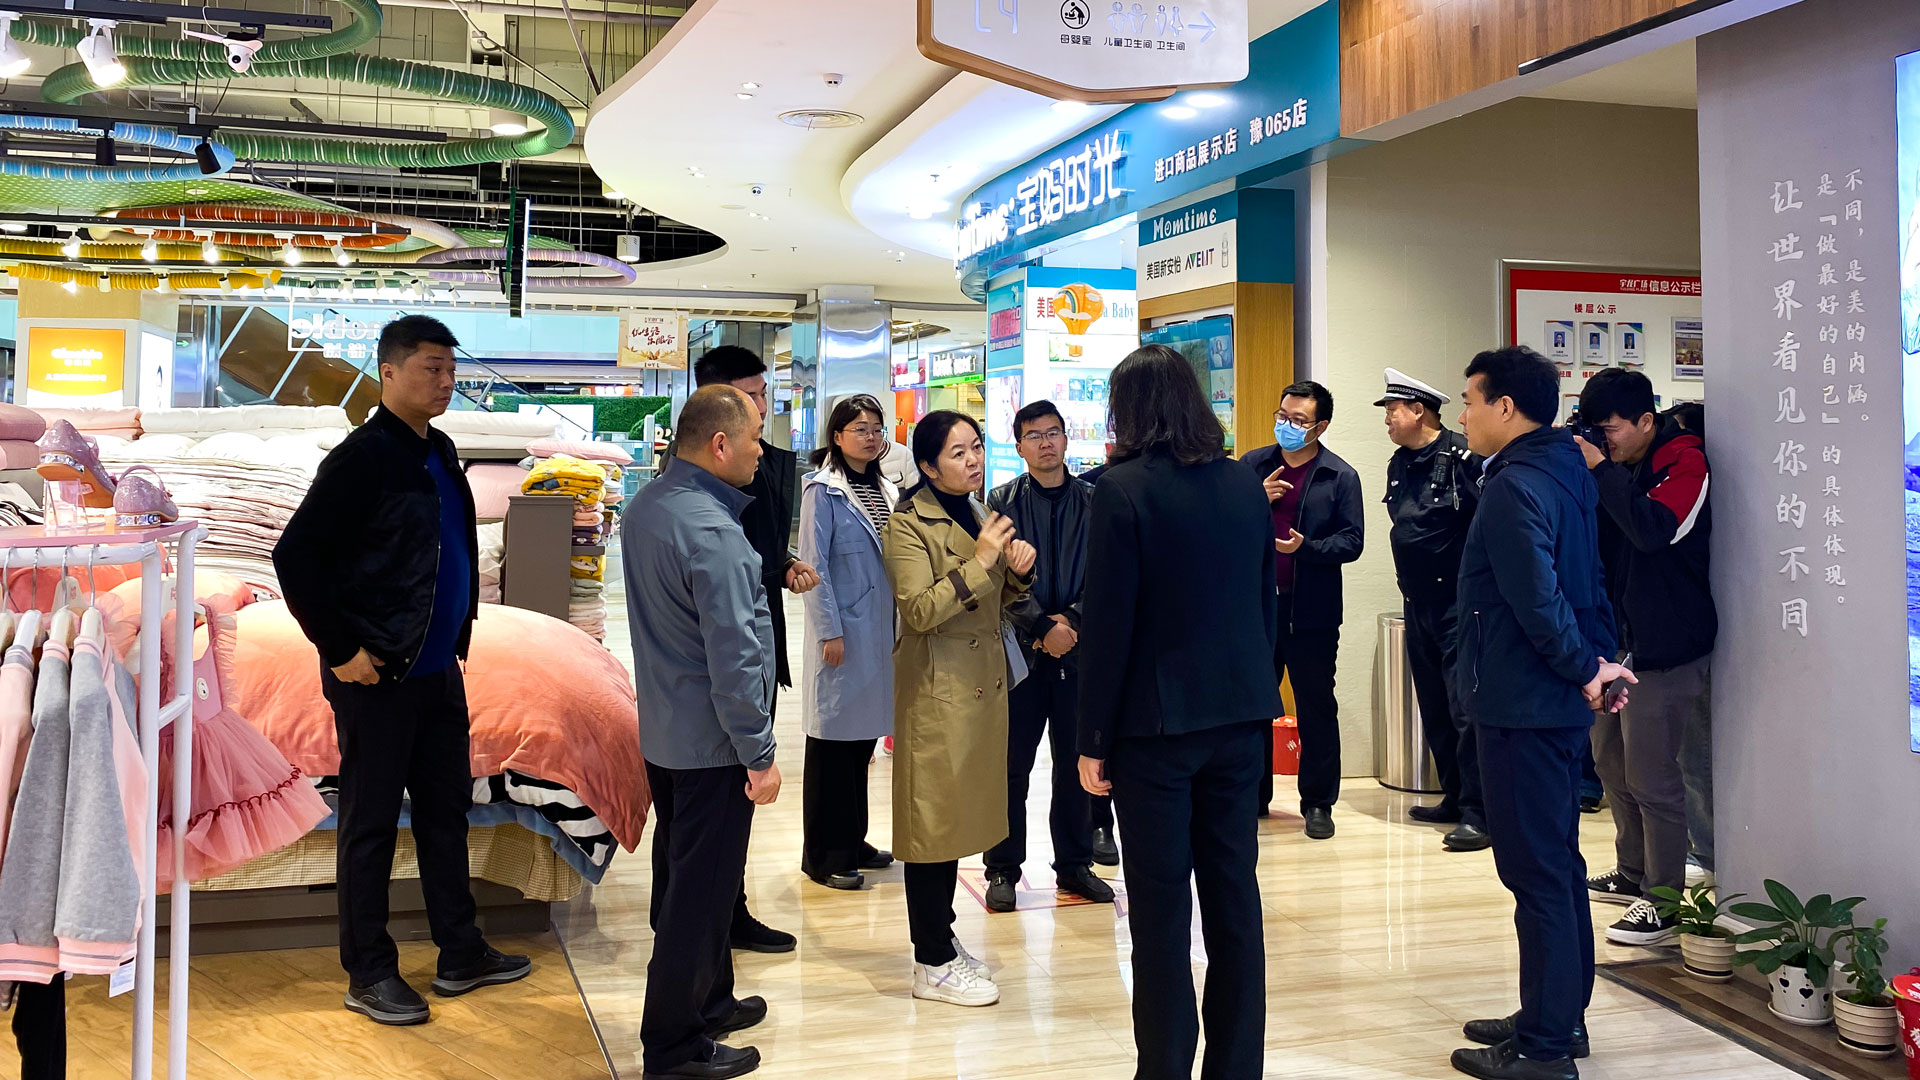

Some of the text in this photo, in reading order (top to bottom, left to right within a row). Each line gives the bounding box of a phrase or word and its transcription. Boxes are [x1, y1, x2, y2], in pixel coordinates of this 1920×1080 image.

[1060, 34, 1092, 46] 母婴室
[1103, 37, 1186, 51] 儿童卫生间 卫生间
[1154, 128, 1238, 183] 进口商品展示店
[1016, 129, 1121, 237] 宝妈时光
[1153, 207, 1217, 241] Momtime
[1146, 257, 1182, 281] 美国新安怡
[1649, 280, 1701, 293] 信息公示栏
[1112, 302, 1135, 321] Baby
[1574, 303, 1617, 314] 楼层公示
[1766, 179, 1811, 639] 让世界看见你的不同
